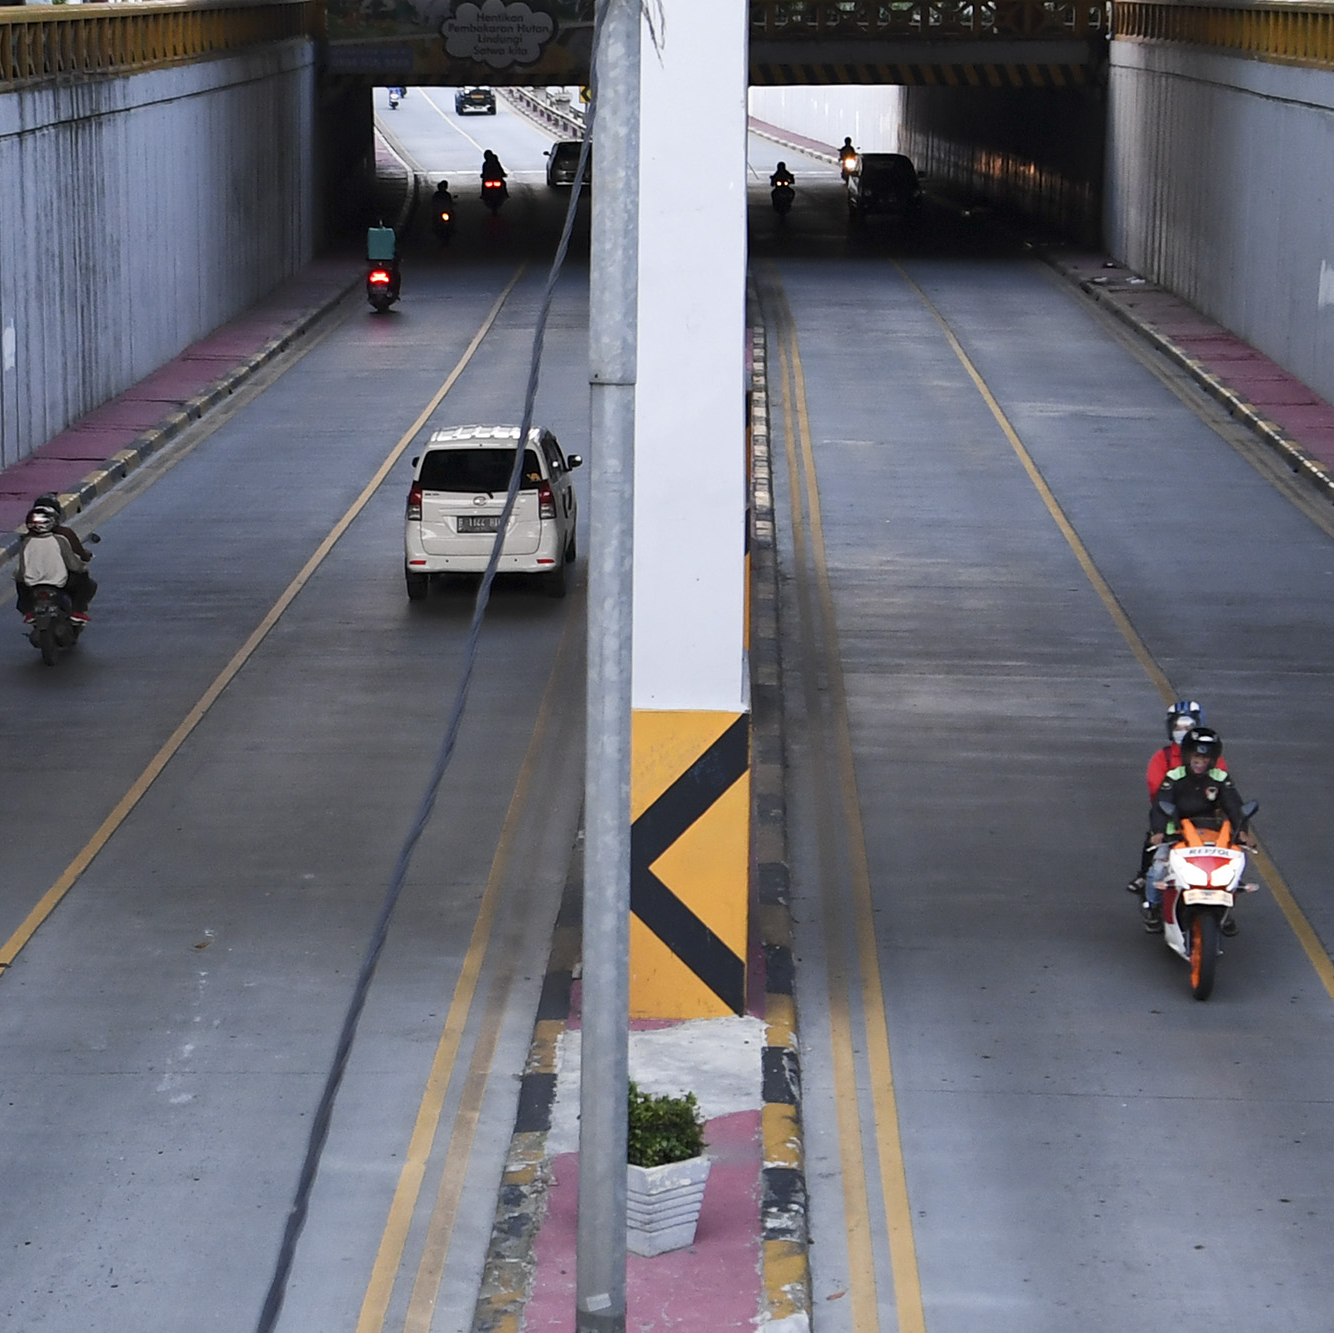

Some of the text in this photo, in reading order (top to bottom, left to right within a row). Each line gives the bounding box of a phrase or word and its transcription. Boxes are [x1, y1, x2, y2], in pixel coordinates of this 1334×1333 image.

[476, 13, 524, 22] Hentikan
[448, 24, 549, 33] Pembakaran Hutan
[478, 34, 523, 45] Lindungi
[474, 46, 528, 55] Satwa kita
[1189, 848, 1230, 857] REPSOL
